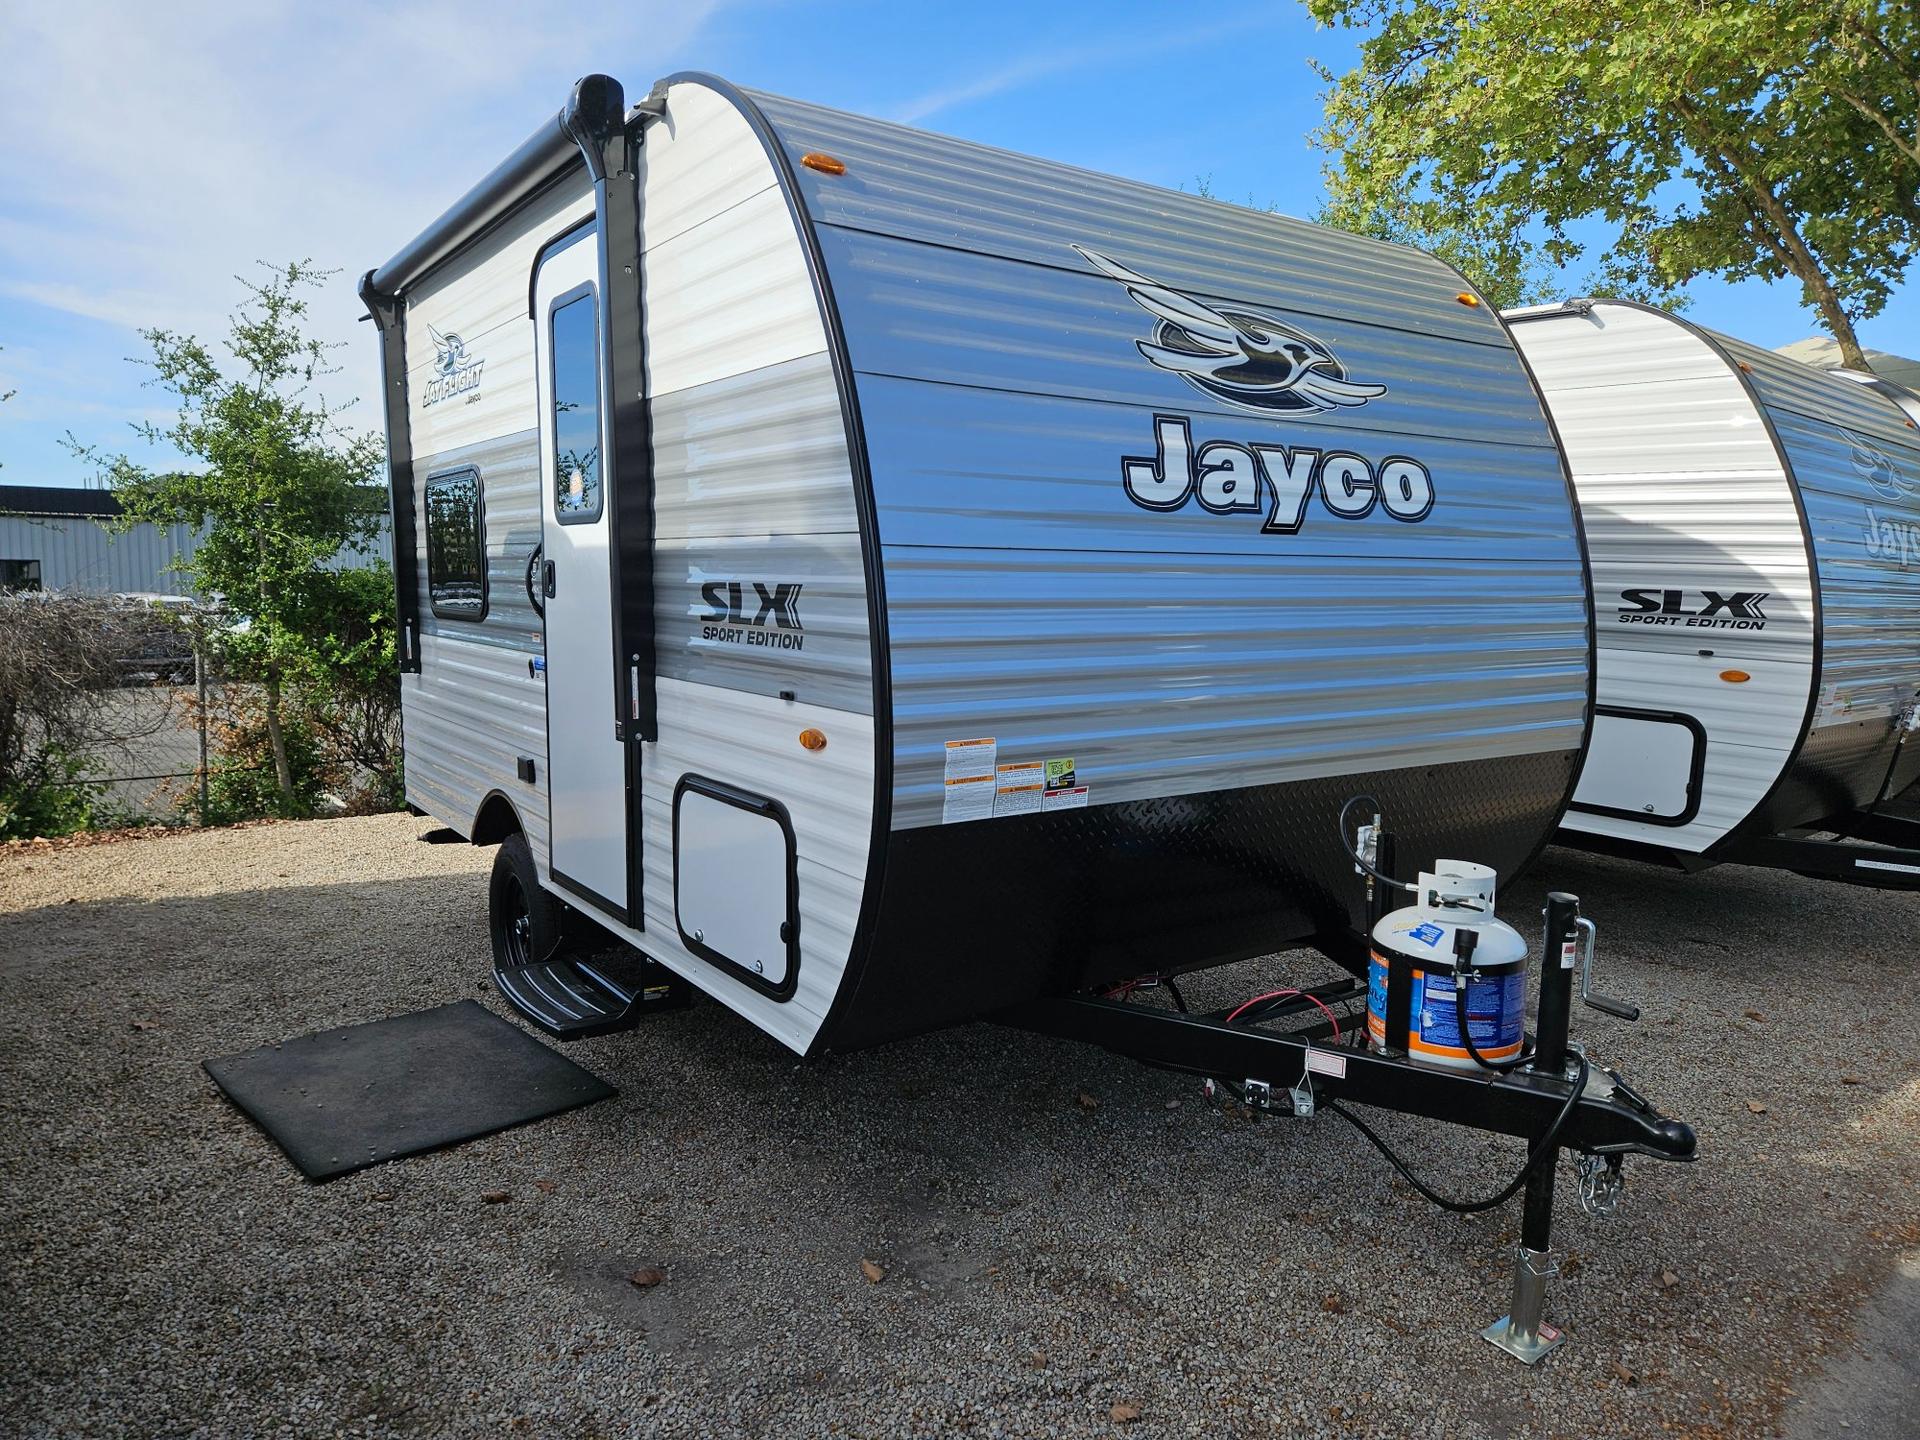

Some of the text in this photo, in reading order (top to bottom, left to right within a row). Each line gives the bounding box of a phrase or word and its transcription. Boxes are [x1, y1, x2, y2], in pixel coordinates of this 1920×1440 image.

[1121, 412, 1436, 535] Jayco
[700, 582, 803, 630] SLX
[1618, 588, 1770, 619] SLX
[1618, 614, 1766, 631] SPORT EDITION
[702, 626, 804, 651] SPORT EDITION
